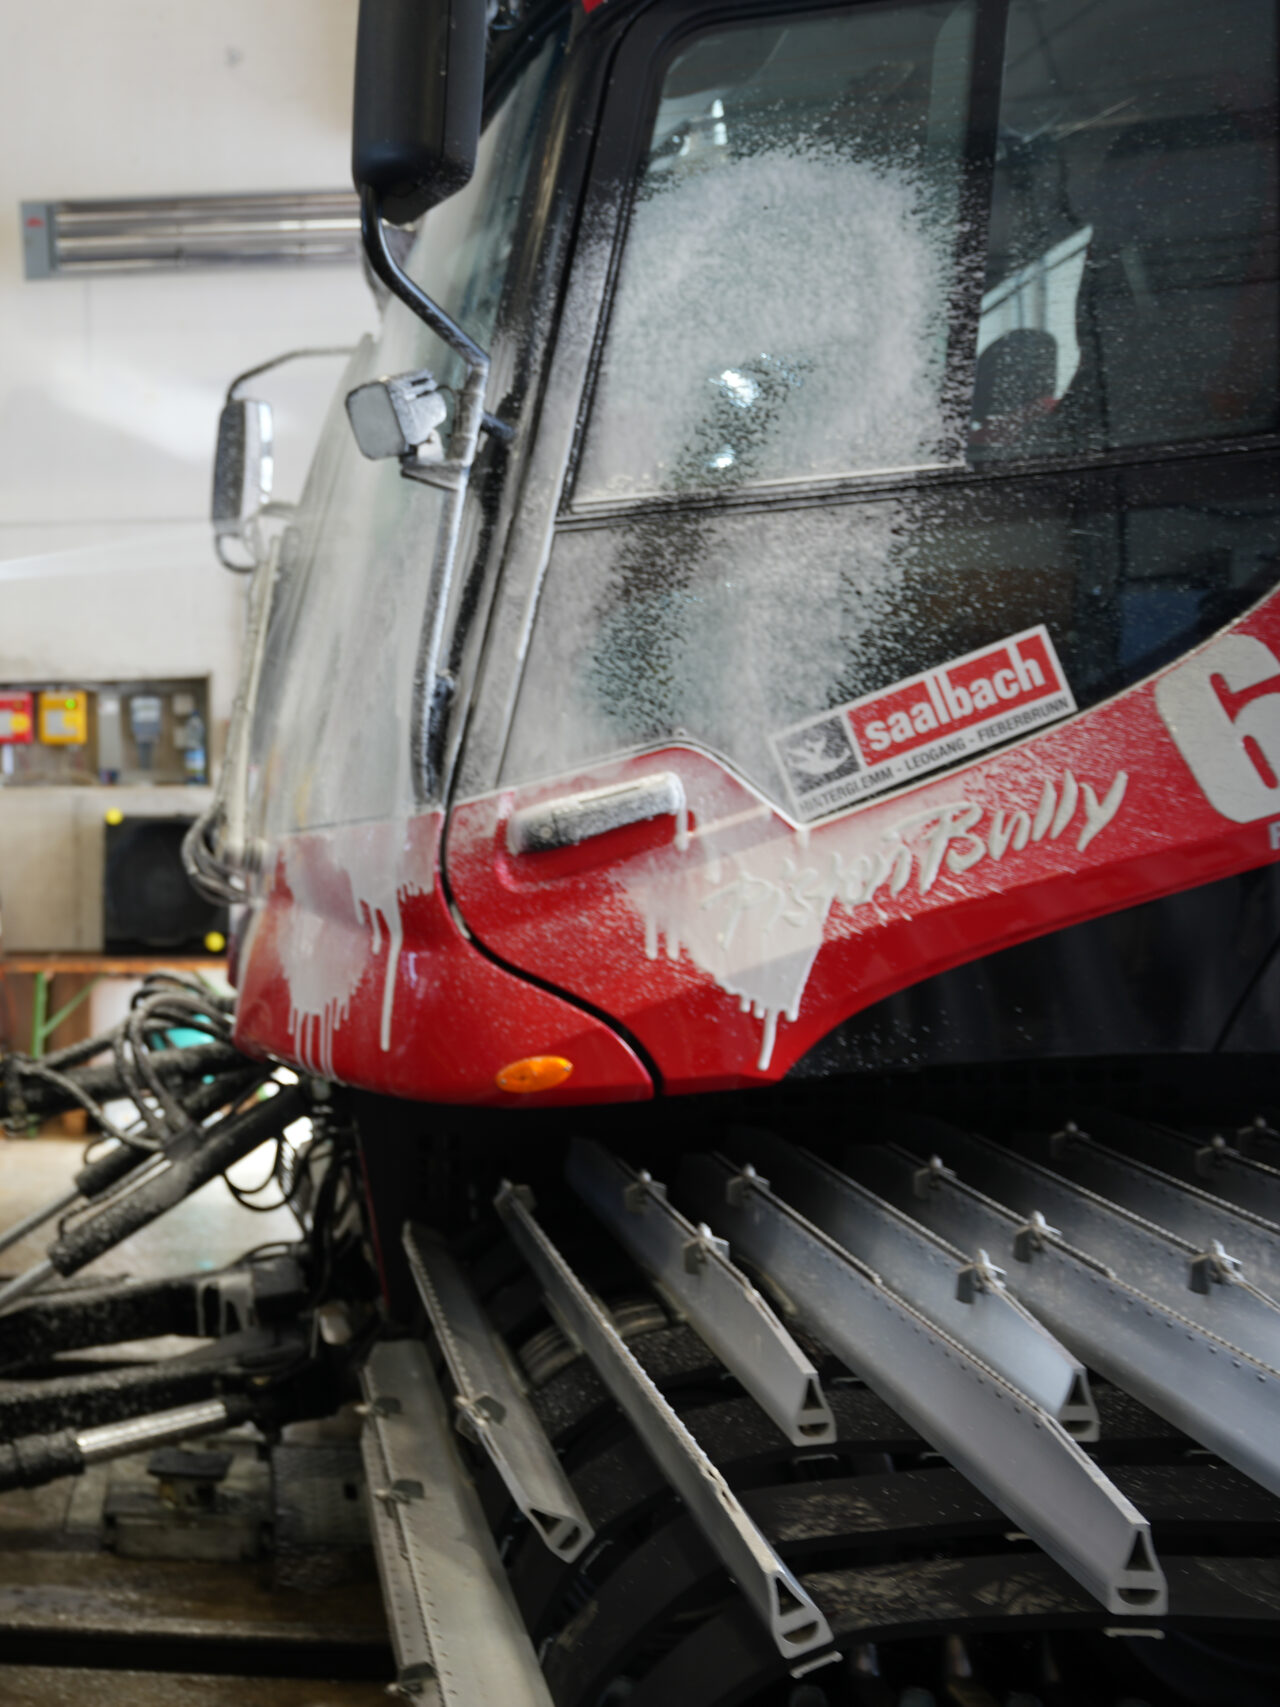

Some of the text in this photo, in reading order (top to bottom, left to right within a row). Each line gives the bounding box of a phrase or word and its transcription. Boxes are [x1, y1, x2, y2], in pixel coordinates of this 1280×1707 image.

[799, 766, 895, 814] HINTERGLEMM
[903, 737, 967, 773] LEOGANG
[976, 696, 1070, 744] FIEBERBRUNN
[864, 641, 1047, 752] saalbach
[1155, 633, 1280, 824] 6
